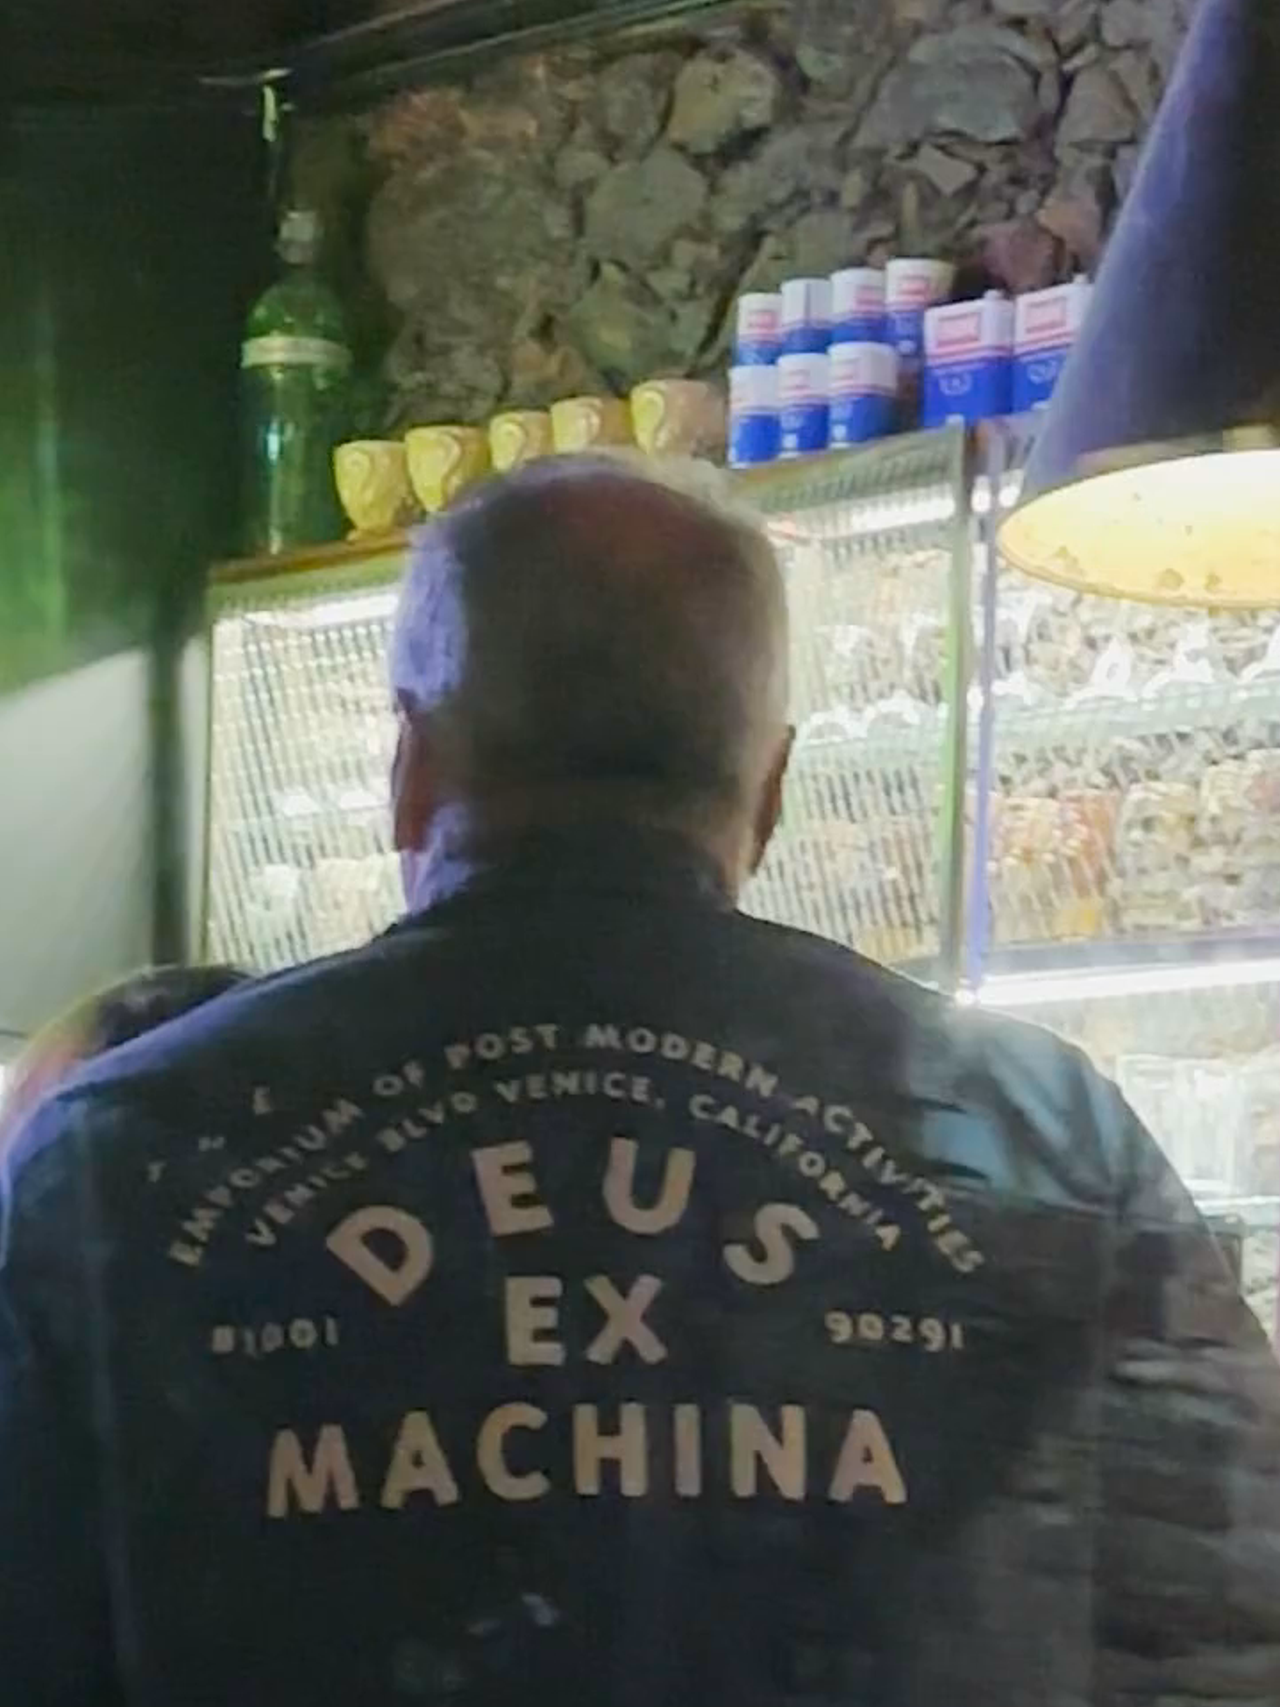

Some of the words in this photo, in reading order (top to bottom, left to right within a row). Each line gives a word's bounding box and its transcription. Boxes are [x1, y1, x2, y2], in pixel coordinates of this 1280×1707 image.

[169, 1097, 366, 1267] EMPORIUM
[373, 1060, 426, 1097] OF
[444, 1023, 560, 1070] POST
[584, 1022, 778, 1097] MODERN
[792, 1095, 986, 1273] ACTIVITIES
[245, 1151, 367, 1245] VENICE
[494, 1071, 666, 1110] VENICE,
[689, 1094, 901, 1252] CALIFORNIA
[326, 1135, 819, 1308] DEUS
[505, 1273, 668, 1366] EX
[824, 1309, 964, 1353] 90291
[265, 1402, 908, 1519] MACHINA
